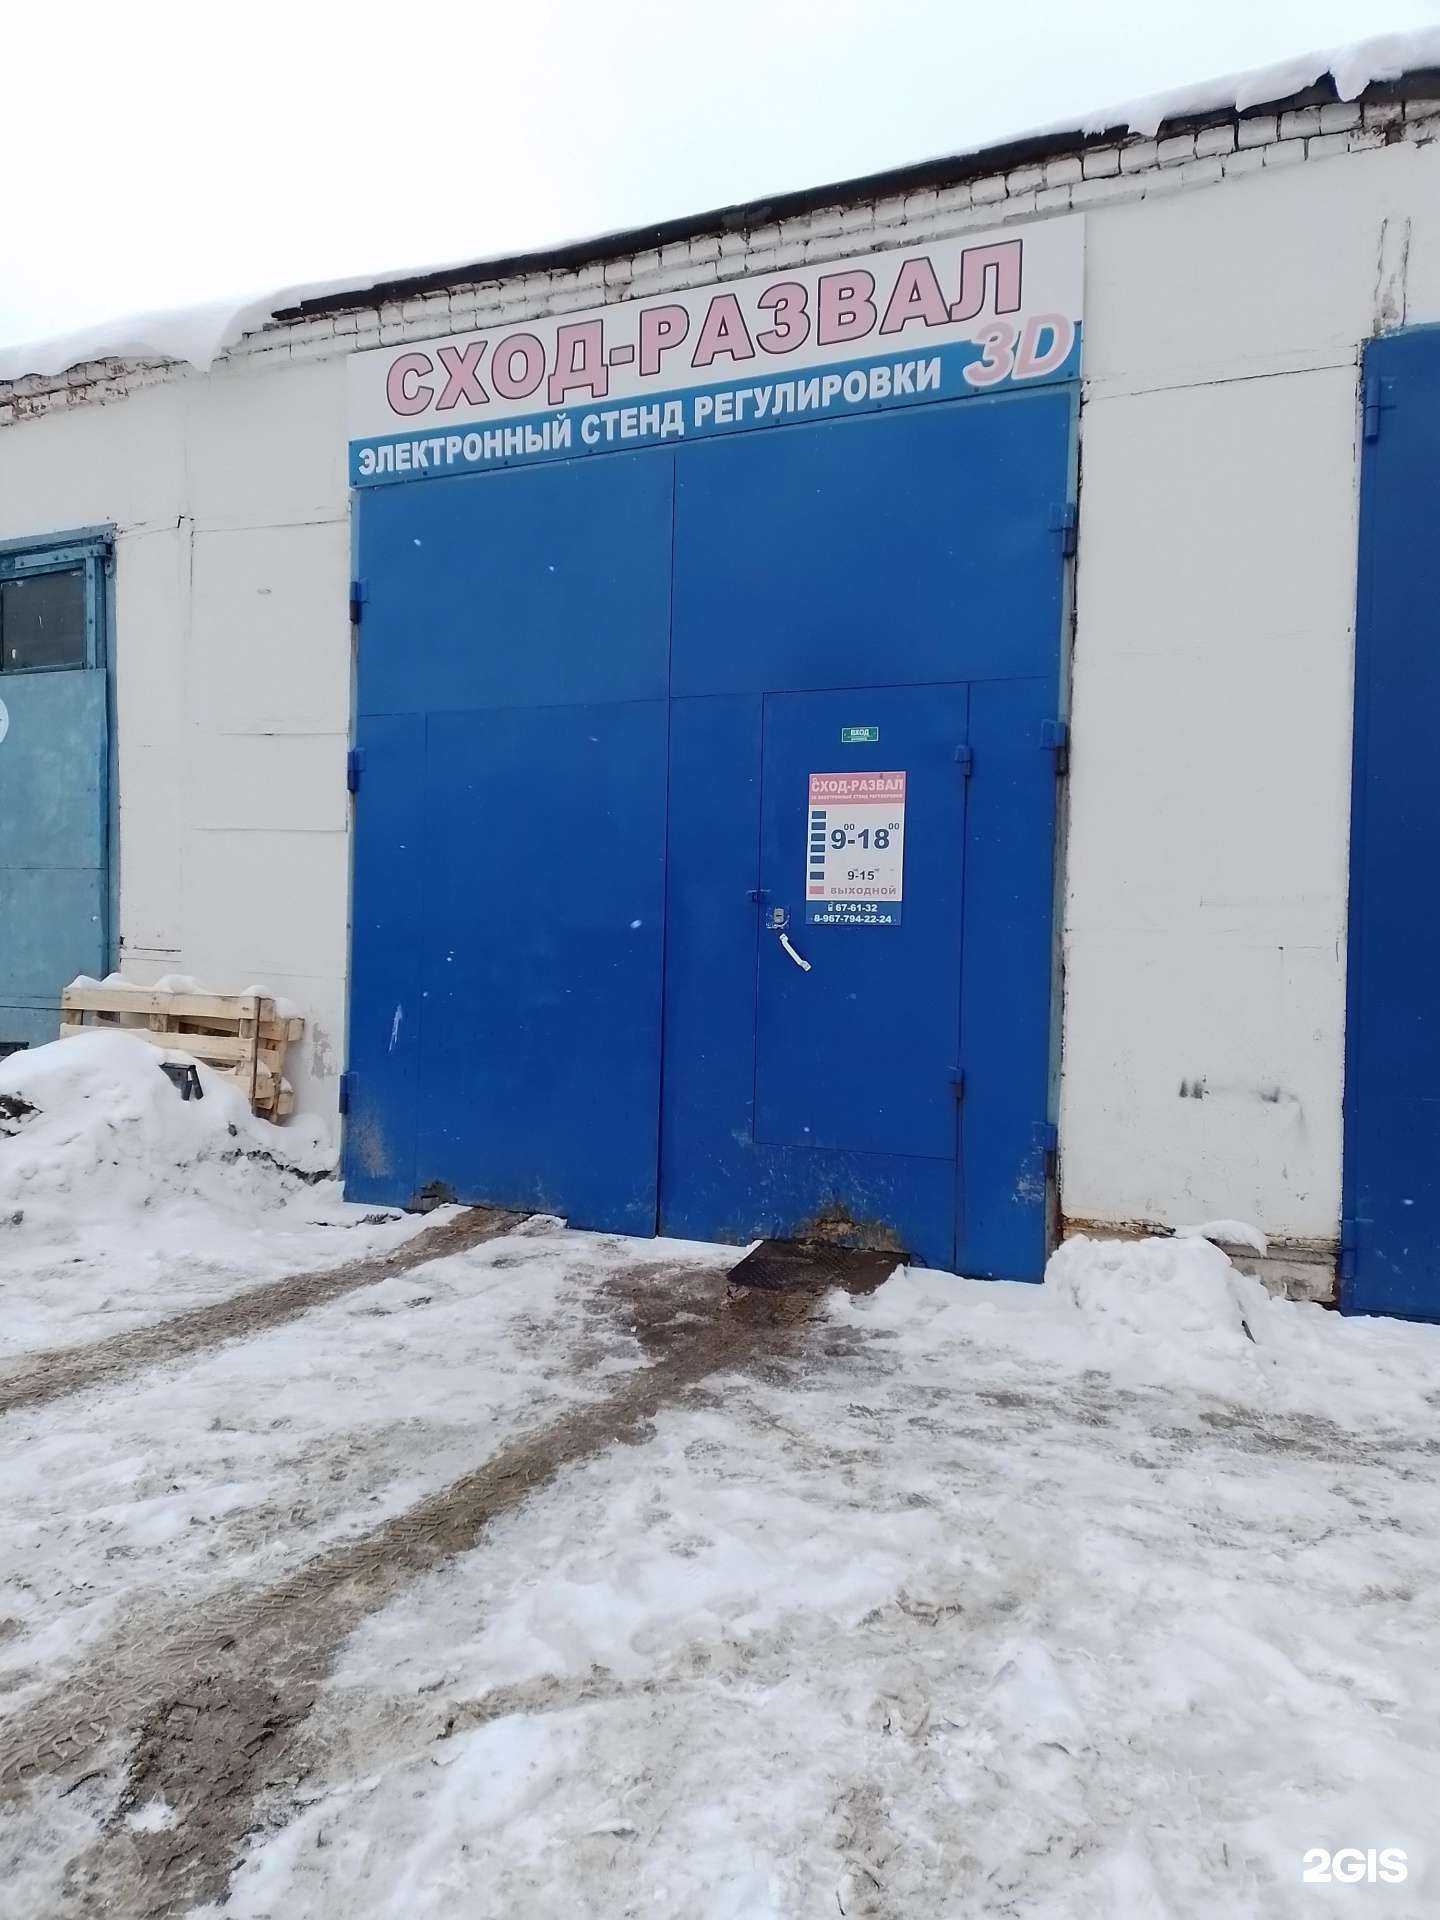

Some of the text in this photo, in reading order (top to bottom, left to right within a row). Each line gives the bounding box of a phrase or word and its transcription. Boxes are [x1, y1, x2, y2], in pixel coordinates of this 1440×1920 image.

[386, 239, 1023, 417] СХОД-РАЗВАЛ
[963, 313, 1075, 387] 3D
[358, 357, 941, 476] ЭЛЕКТРОННЫЙ СТЕНД РЕГУЛИРОВКИ
[811, 778, 904, 794] СХОД-РАЗВАЛ
[830, 885, 897, 896] ВЫХОДНОЙ
[835, 903, 878, 912] 67-61-32
